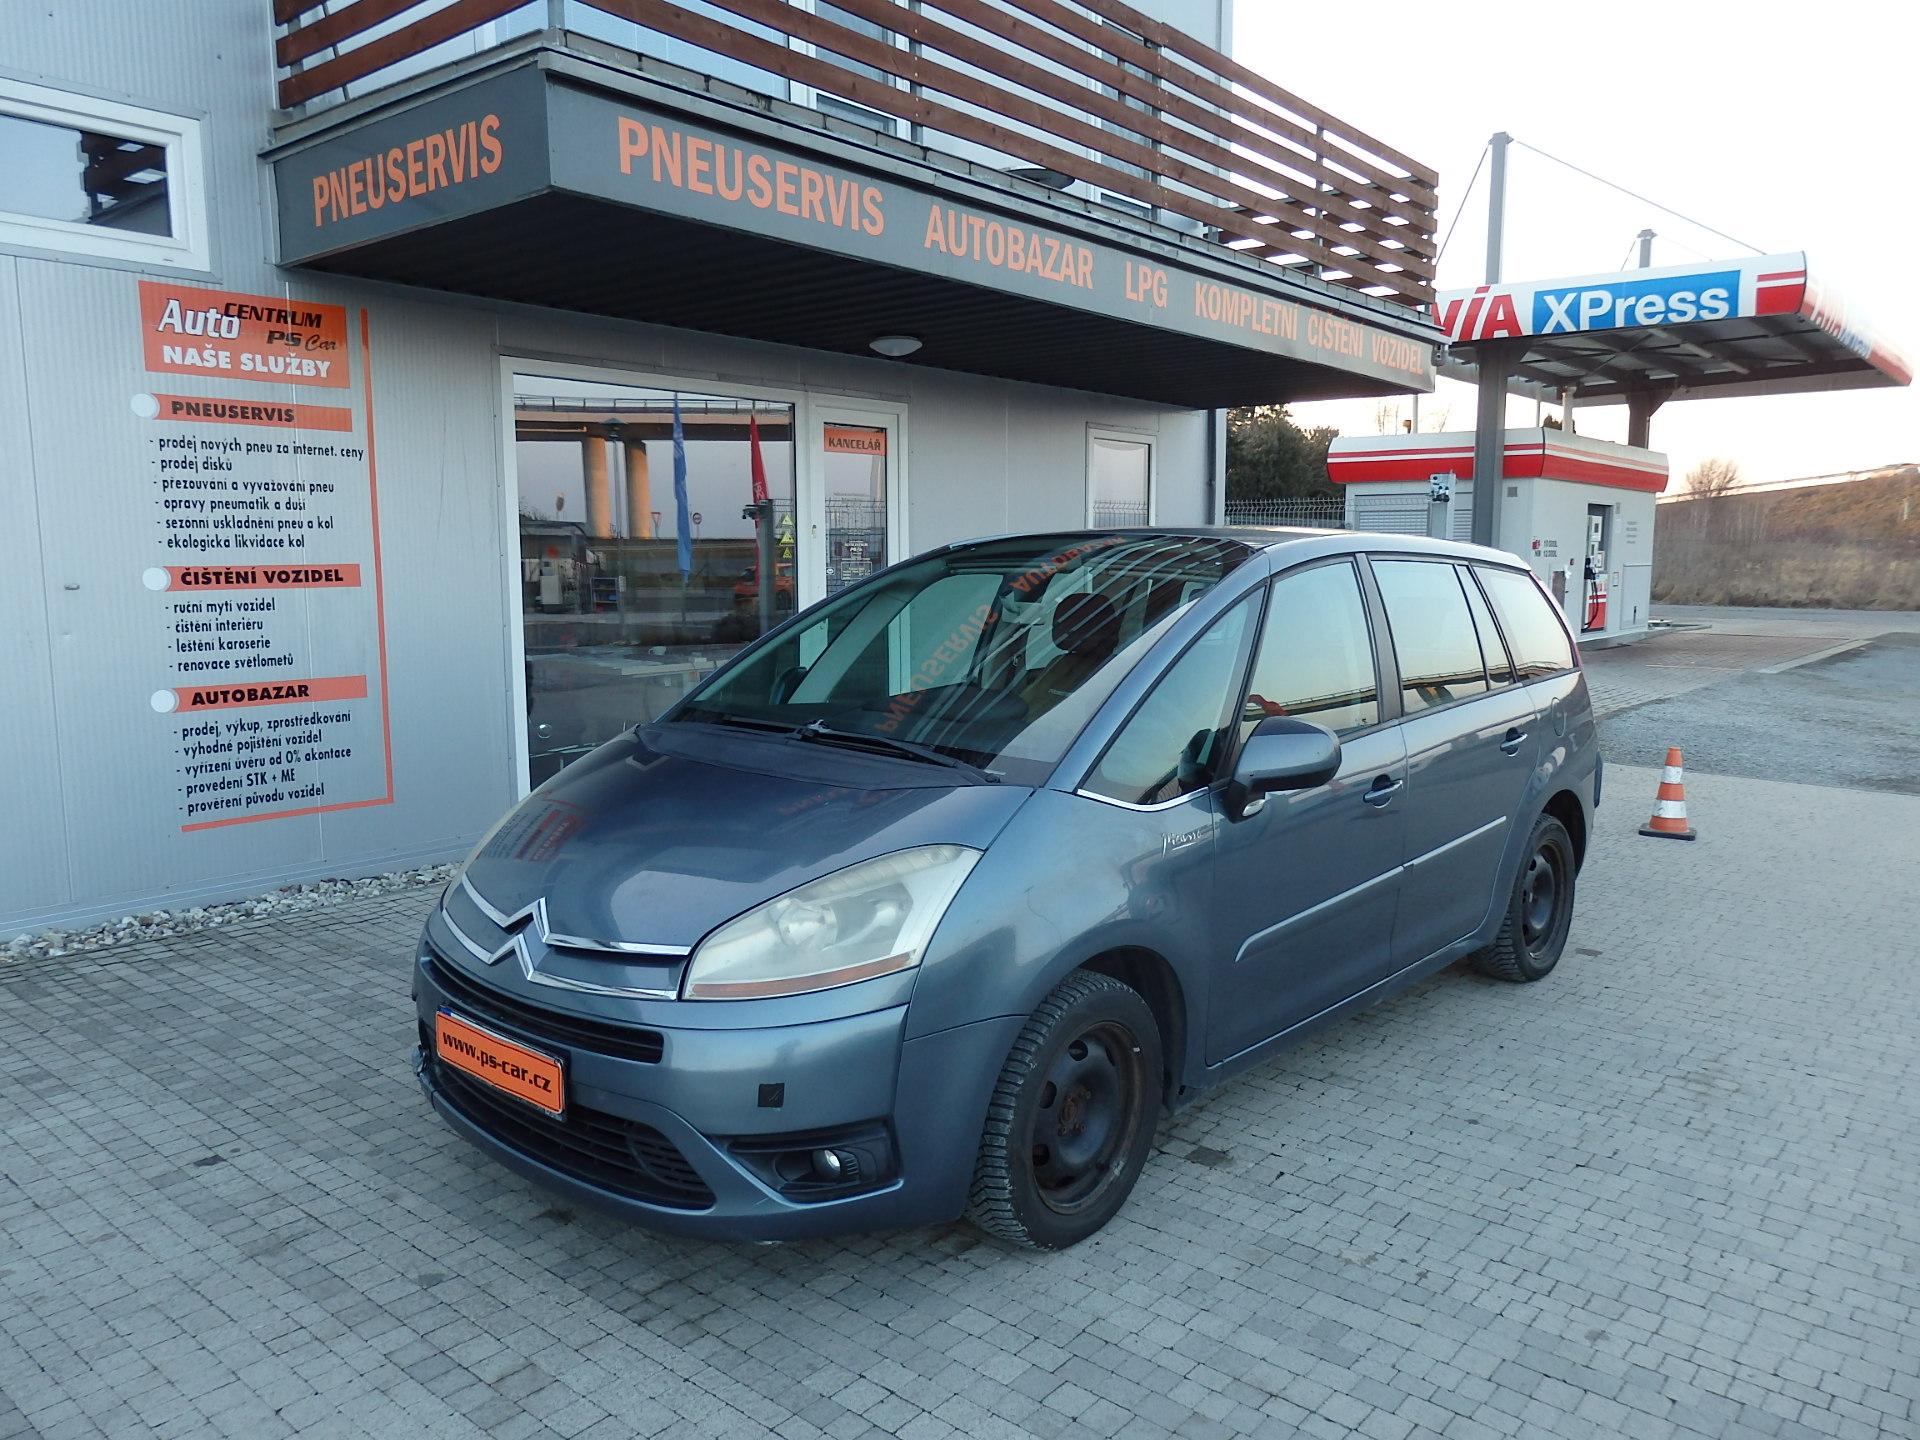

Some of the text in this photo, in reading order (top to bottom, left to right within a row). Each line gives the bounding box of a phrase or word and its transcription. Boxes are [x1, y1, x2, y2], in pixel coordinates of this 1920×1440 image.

[312, 113, 502, 227] PNEUSERVIS
[617, 116, 1425, 376] PNEUSERVIS AUTOBAZAR LPG KOMPLETNÍ ČIŠTĚNÍ VOZIDEL
[156, 297, 323, 340] Auto CENTRUM
[1541, 287, 1730, 334] XPress
[266, 330, 338, 352] PS Car
[162, 343, 332, 379] NAŠE SLUŽBY
[171, 400, 296, 423] PNEUSERVIS
[159, 434, 197, 454] prodej
[201, 437, 242, 455] nových
[246, 441, 273, 455] pneu
[276, 443, 289, 454] za
[340, 447, 364, 461] ceny
[828, 435, 882, 452] KANCELÁŘ
[160, 455, 233, 474] prodej disků
[162, 476, 335, 496] přezouvání a vyvažování pneu
[164, 496, 306, 513] opravy pneumatik a duší
[213, 514, 275, 530] uskladnění
[277, 518, 304, 533] pneu
[307, 519, 314, 530] a
[317, 515, 334, 530] kol
[167, 533, 305, 552] ekologická likvidace kol
[180, 566, 344, 586] ČIŠTĚNÍ VOZIDEL
[173, 600, 203, 615] ruční
[236, 597, 276, 612] vozidel
[175, 616, 264, 633] čištění interiéru
[176, 635, 271, 653] leštění karoserie
[177, 653, 294, 672] renovace světlometů
[191, 684, 310, 706] AUTOBAZAR
[182, 720, 222, 741] prodej,
[267, 709, 351, 733] zprostředkování
[183, 729, 322, 760] výhodné pojištění vozidel
[235, 756, 266, 770] úvěru
[269, 751, 282, 766] od
[285, 749, 302, 763] 0%
[304, 747, 352, 761] akontace
[186, 775, 243, 799] provedení
[246, 771, 268, 787] STK
[281, 768, 296, 783] ME
[187, 782, 325, 817] prověření původu vozidel
[442, 1031, 553, 1094] www.ps-car.cz
